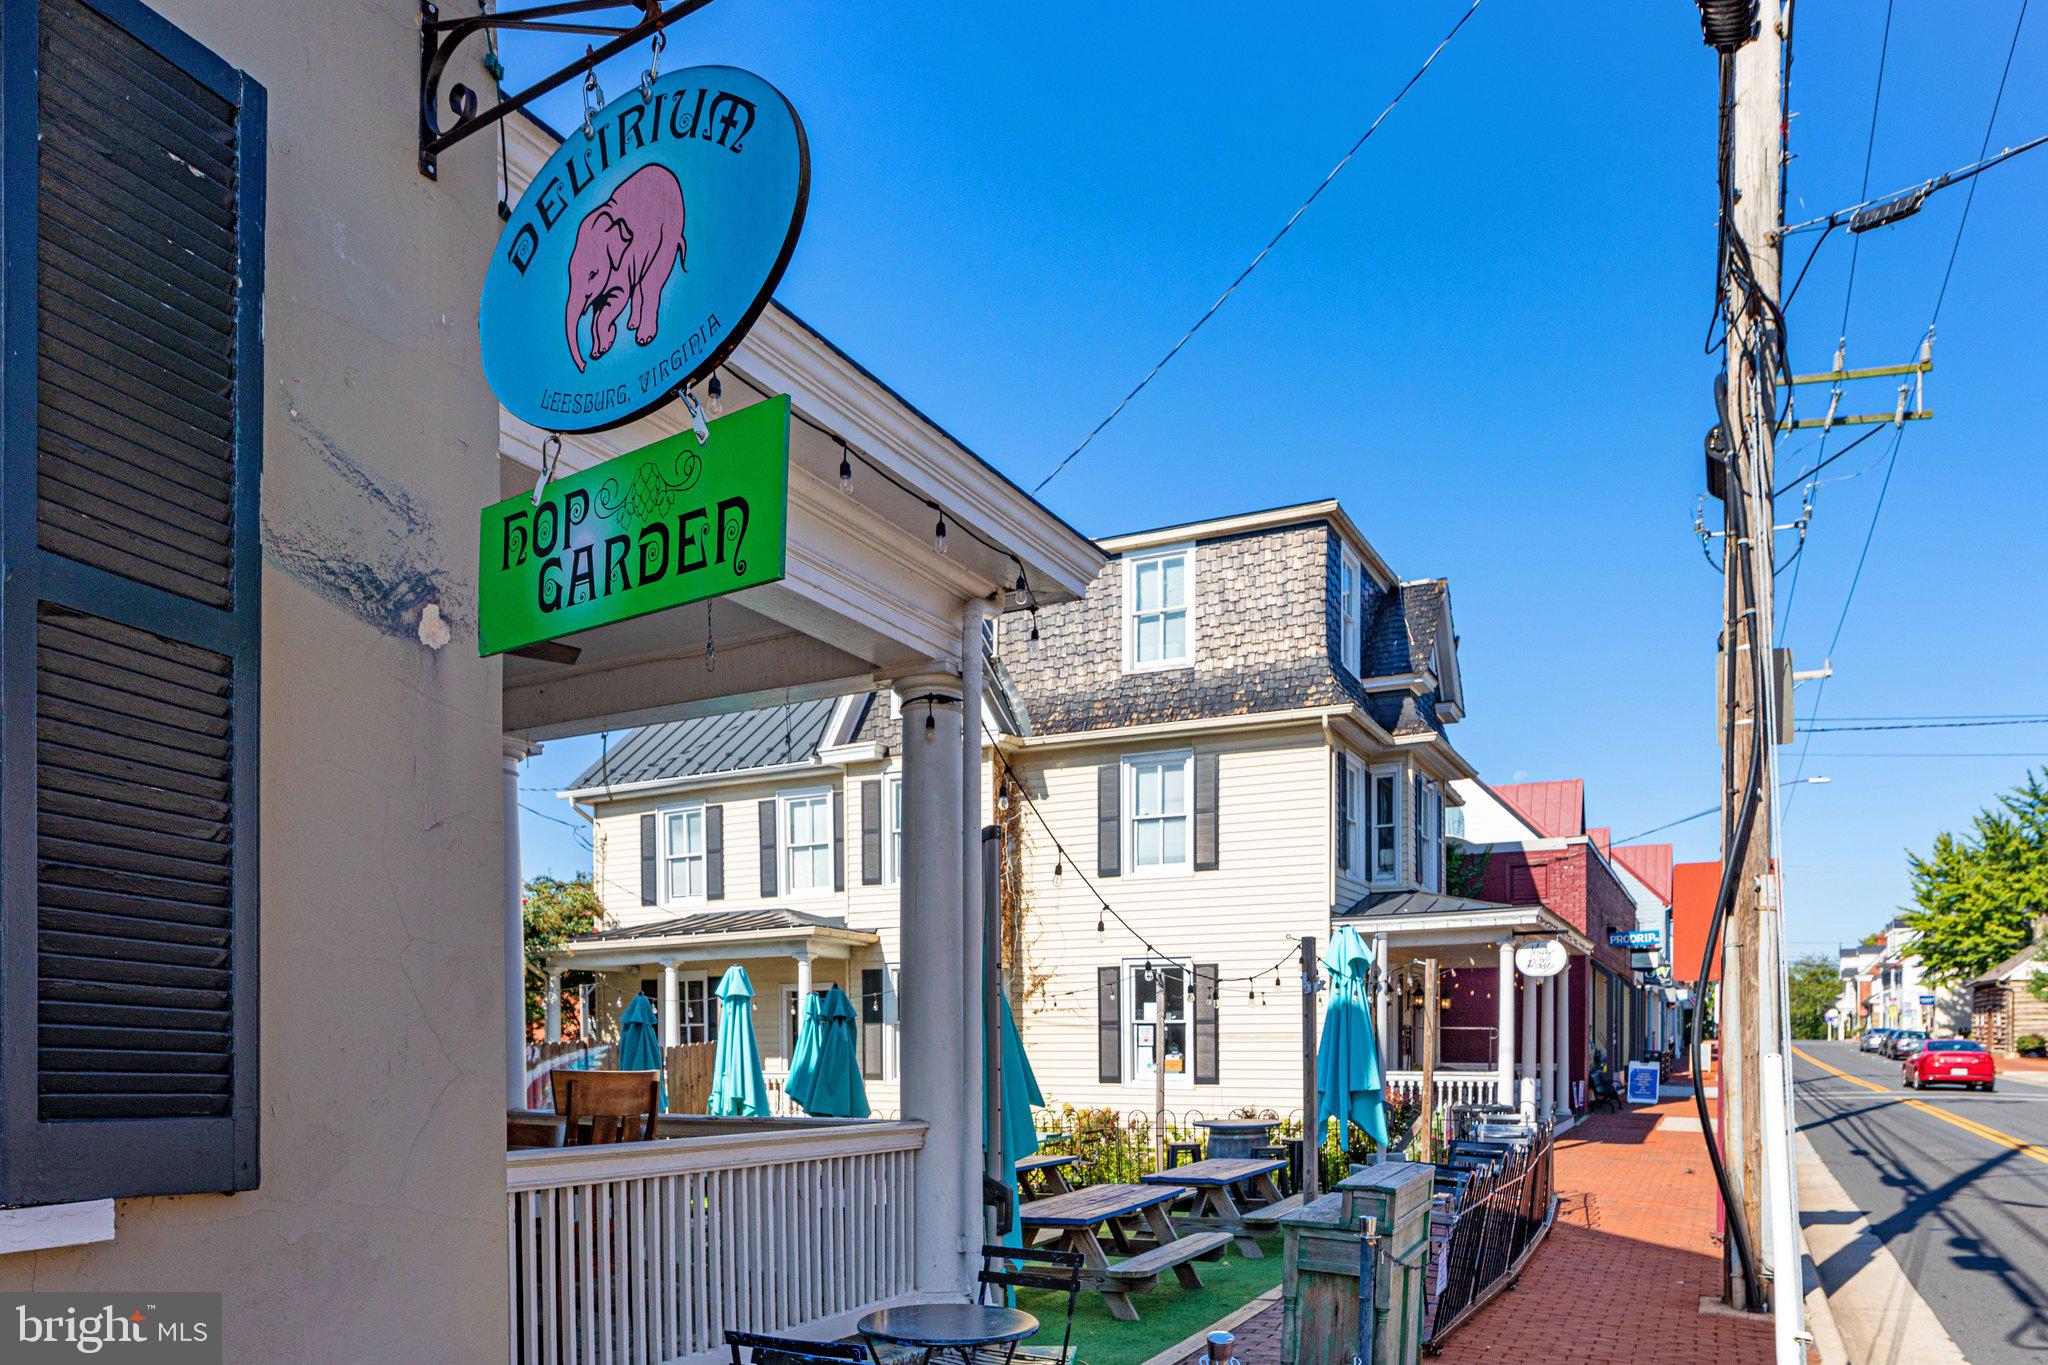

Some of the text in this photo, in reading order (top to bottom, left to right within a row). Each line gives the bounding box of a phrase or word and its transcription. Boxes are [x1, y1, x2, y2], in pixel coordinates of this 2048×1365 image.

[507, 88, 756, 276] DELIRIUM
[638, 313, 722, 392] VIRGINIA
[501, 488, 589, 571] HOP
[538, 496, 750, 613] GARDEN
